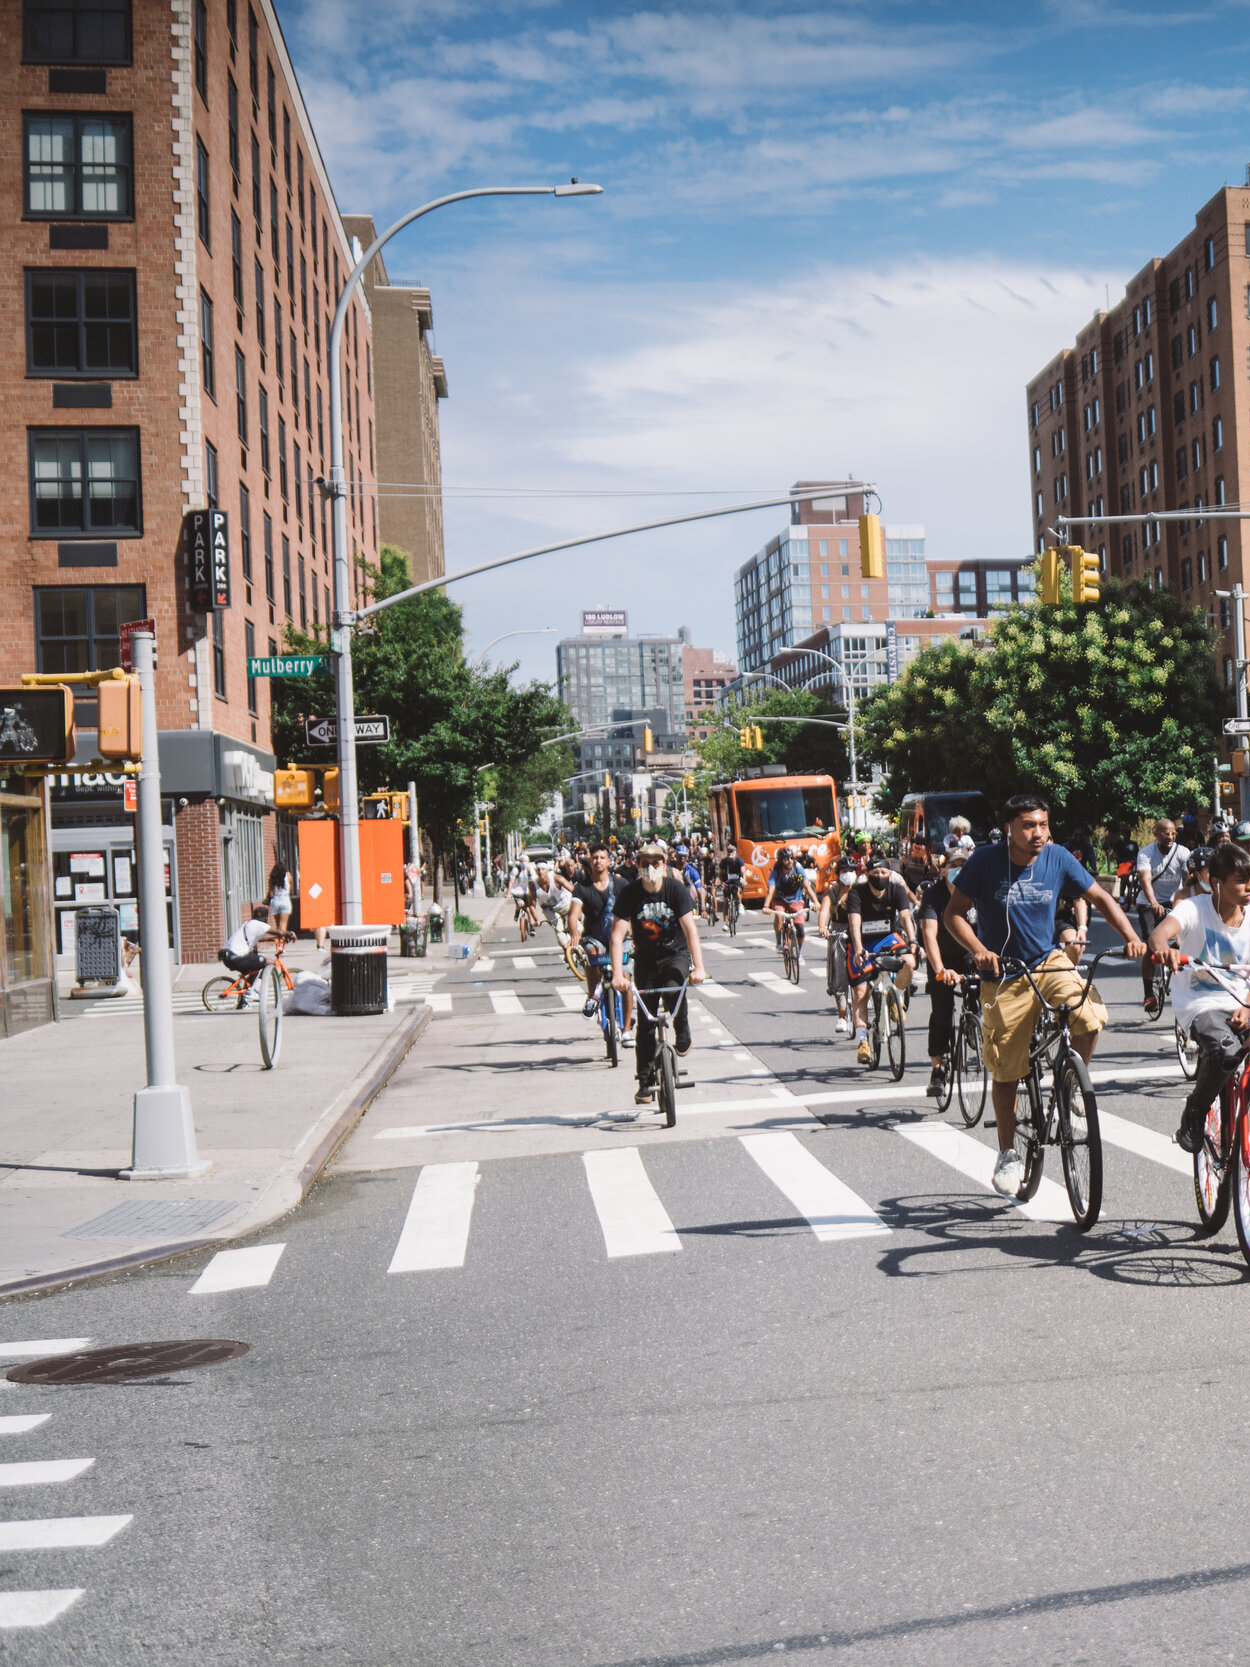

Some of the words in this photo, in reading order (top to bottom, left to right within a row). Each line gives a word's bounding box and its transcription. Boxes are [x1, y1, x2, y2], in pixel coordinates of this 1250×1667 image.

[194, 515, 205, 581] PARK
[214, 513, 226, 581] PARK
[251, 658, 314, 676] Mulberry
[318, 726, 337, 737] ON
[355, 723, 380, 735] WAY
